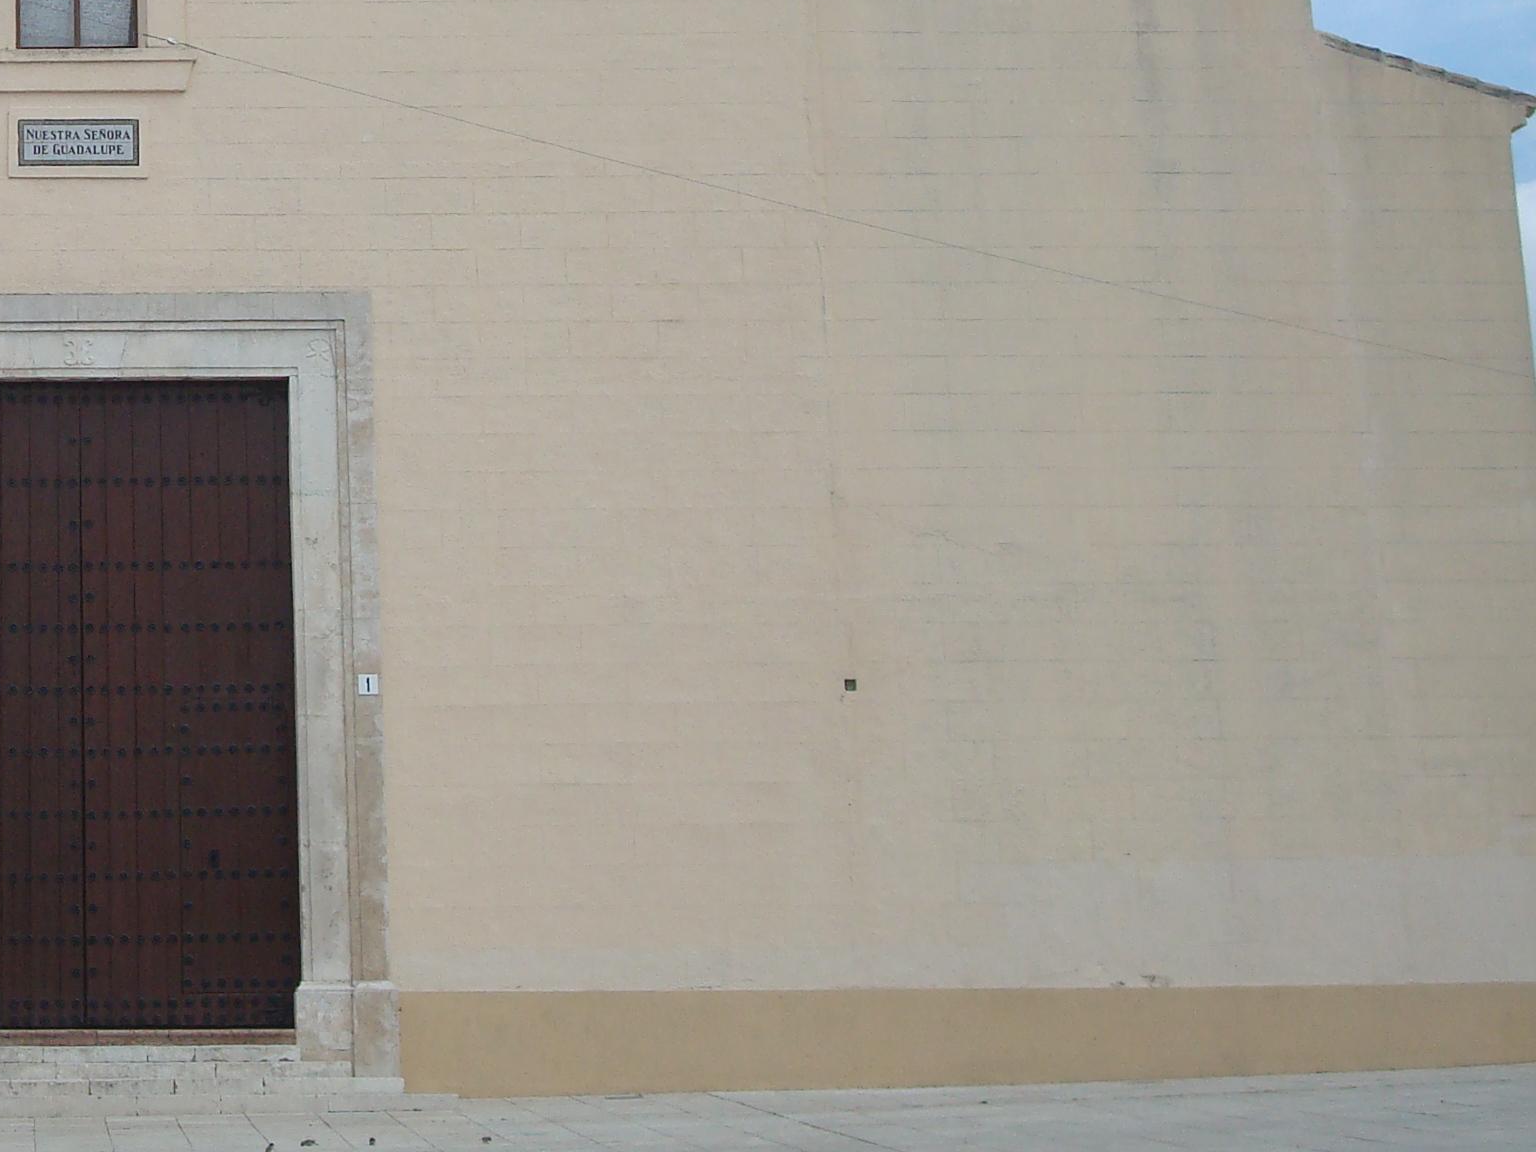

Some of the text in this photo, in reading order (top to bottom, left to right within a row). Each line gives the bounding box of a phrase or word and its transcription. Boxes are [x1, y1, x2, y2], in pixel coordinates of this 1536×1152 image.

[26, 128, 131, 141] NUESTRA SEÑORA
[33, 143, 125, 156] DE GUADALUPE
